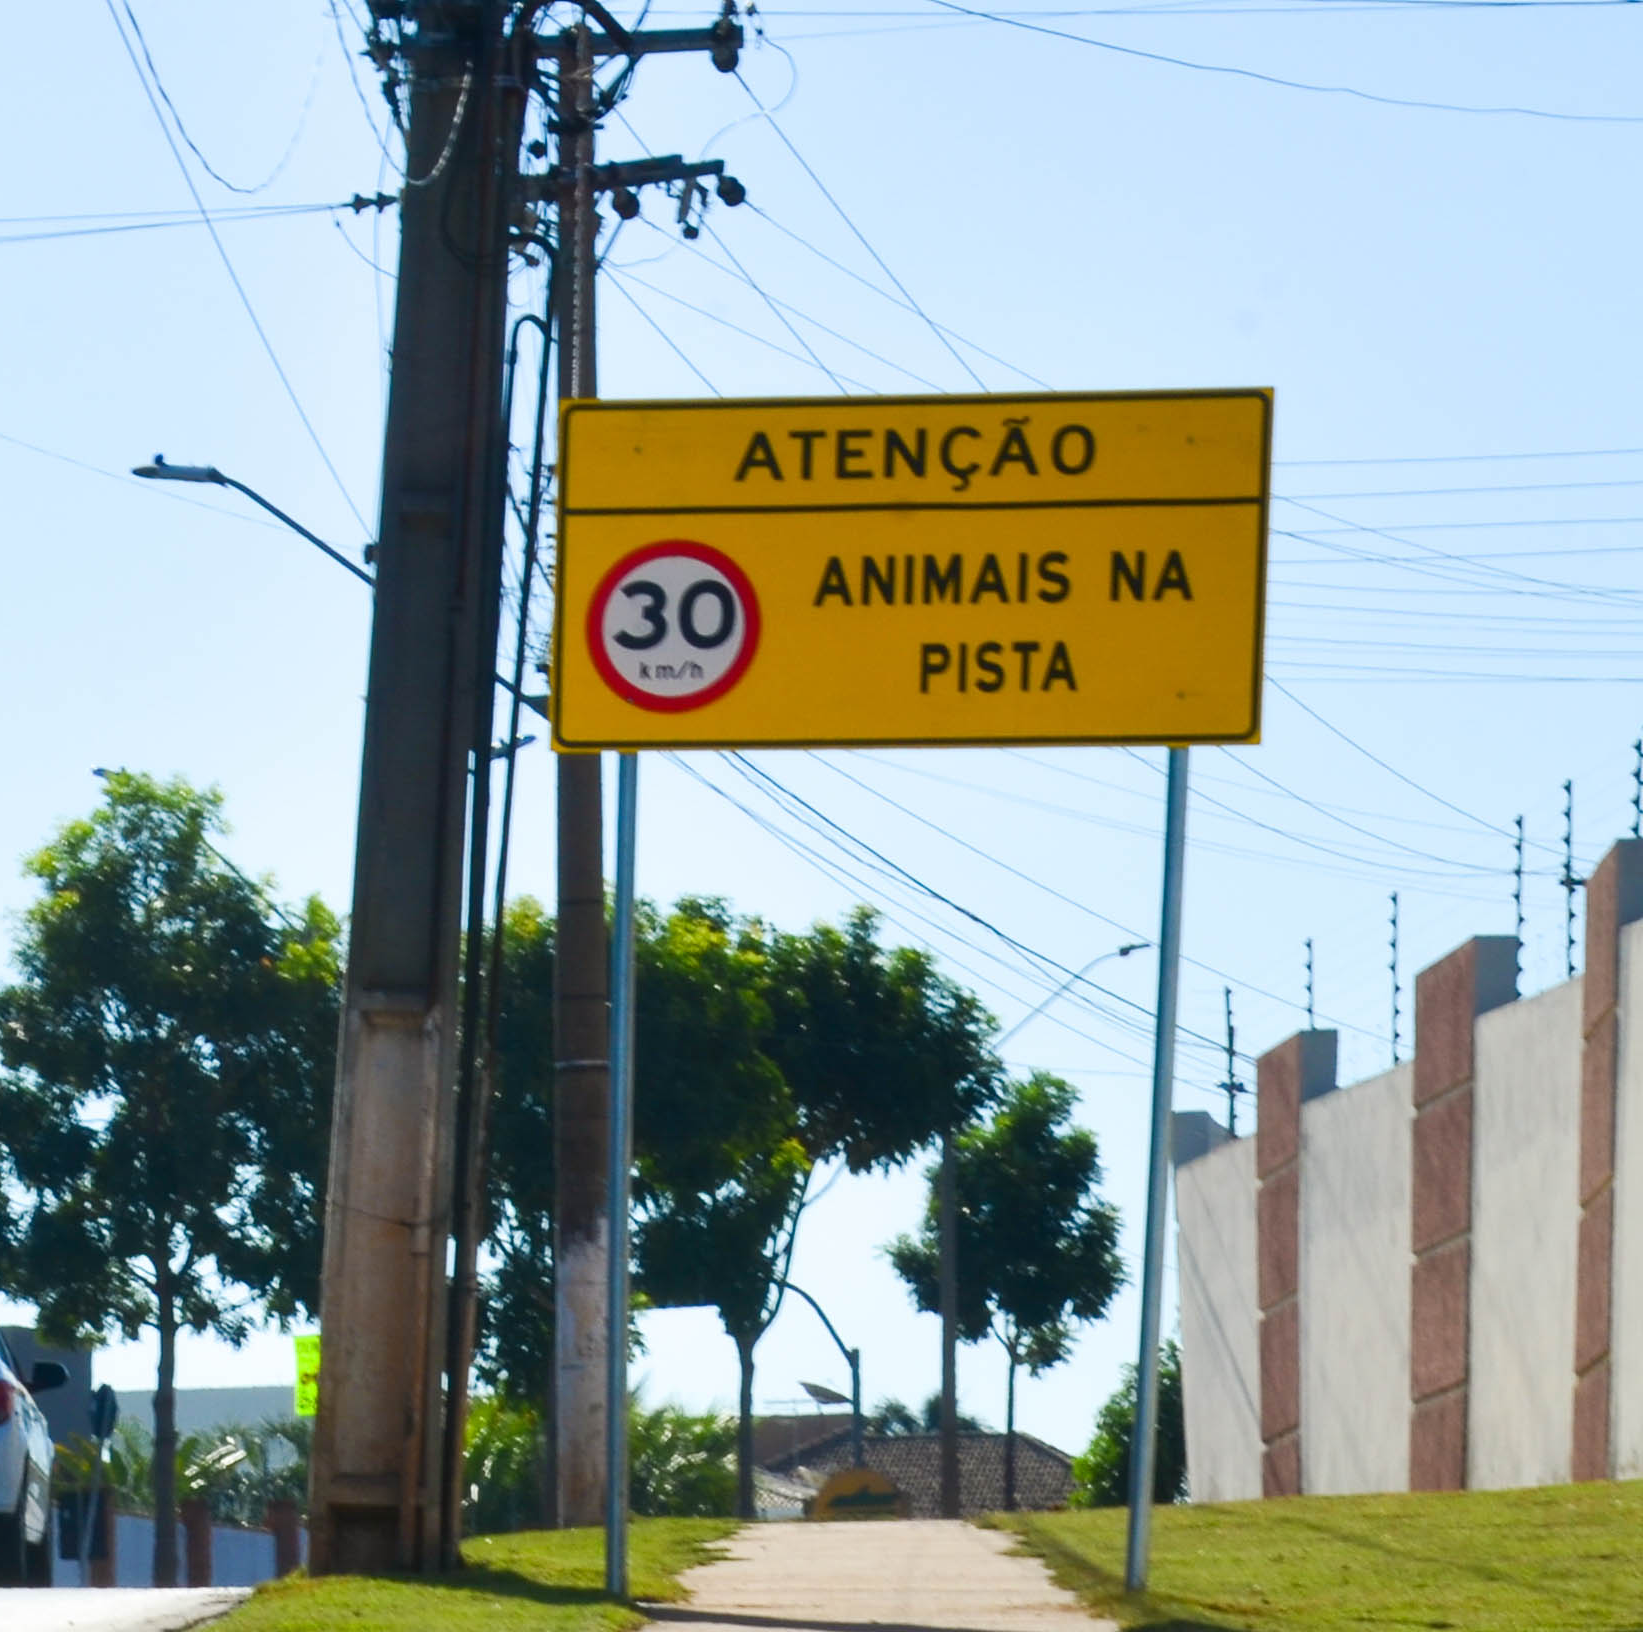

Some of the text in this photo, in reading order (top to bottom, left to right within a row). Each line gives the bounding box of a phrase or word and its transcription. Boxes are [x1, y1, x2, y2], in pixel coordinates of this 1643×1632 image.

[733, 417, 1097, 493] ATENÇÃO
[813, 550, 1194, 607] ANIMAIS NA
[612, 579, 737, 651] 30
[638, 658, 705, 682] km/h
[918, 640, 1078, 695] PISTA
